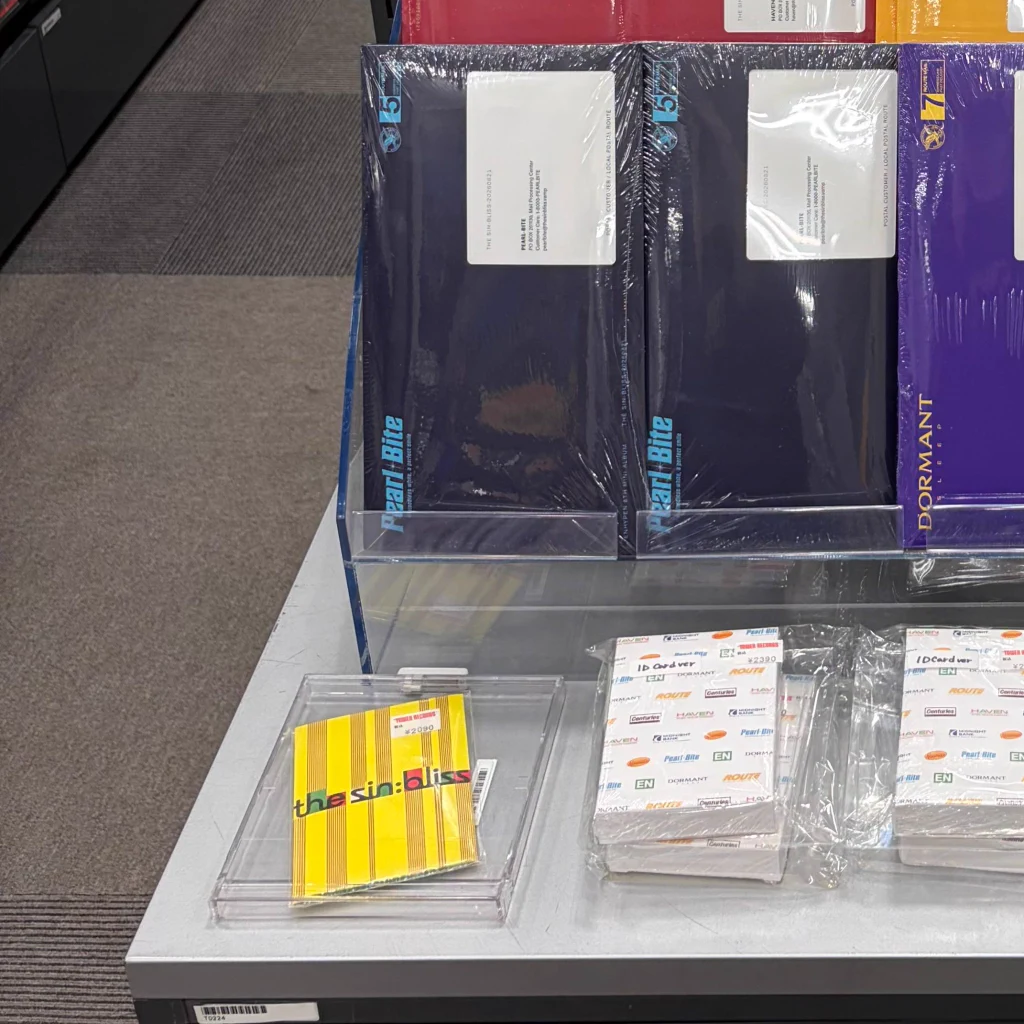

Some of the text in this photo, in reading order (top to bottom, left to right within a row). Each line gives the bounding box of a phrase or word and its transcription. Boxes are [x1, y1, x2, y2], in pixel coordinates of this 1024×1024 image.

[379, 97, 400, 114] 5
[653, 96, 677, 113] 5
[921, 94, 945, 110] 7
[646, 416, 672, 464] Bite
[918, 394, 932, 530] DORMANT
[381, 415, 404, 532] Pearl Bite
[729, 667, 766, 675] ROUTE
[655, 691, 692, 701] ROUTE
[714, 752, 730, 761] EN
[293, 789, 346, 818] the
